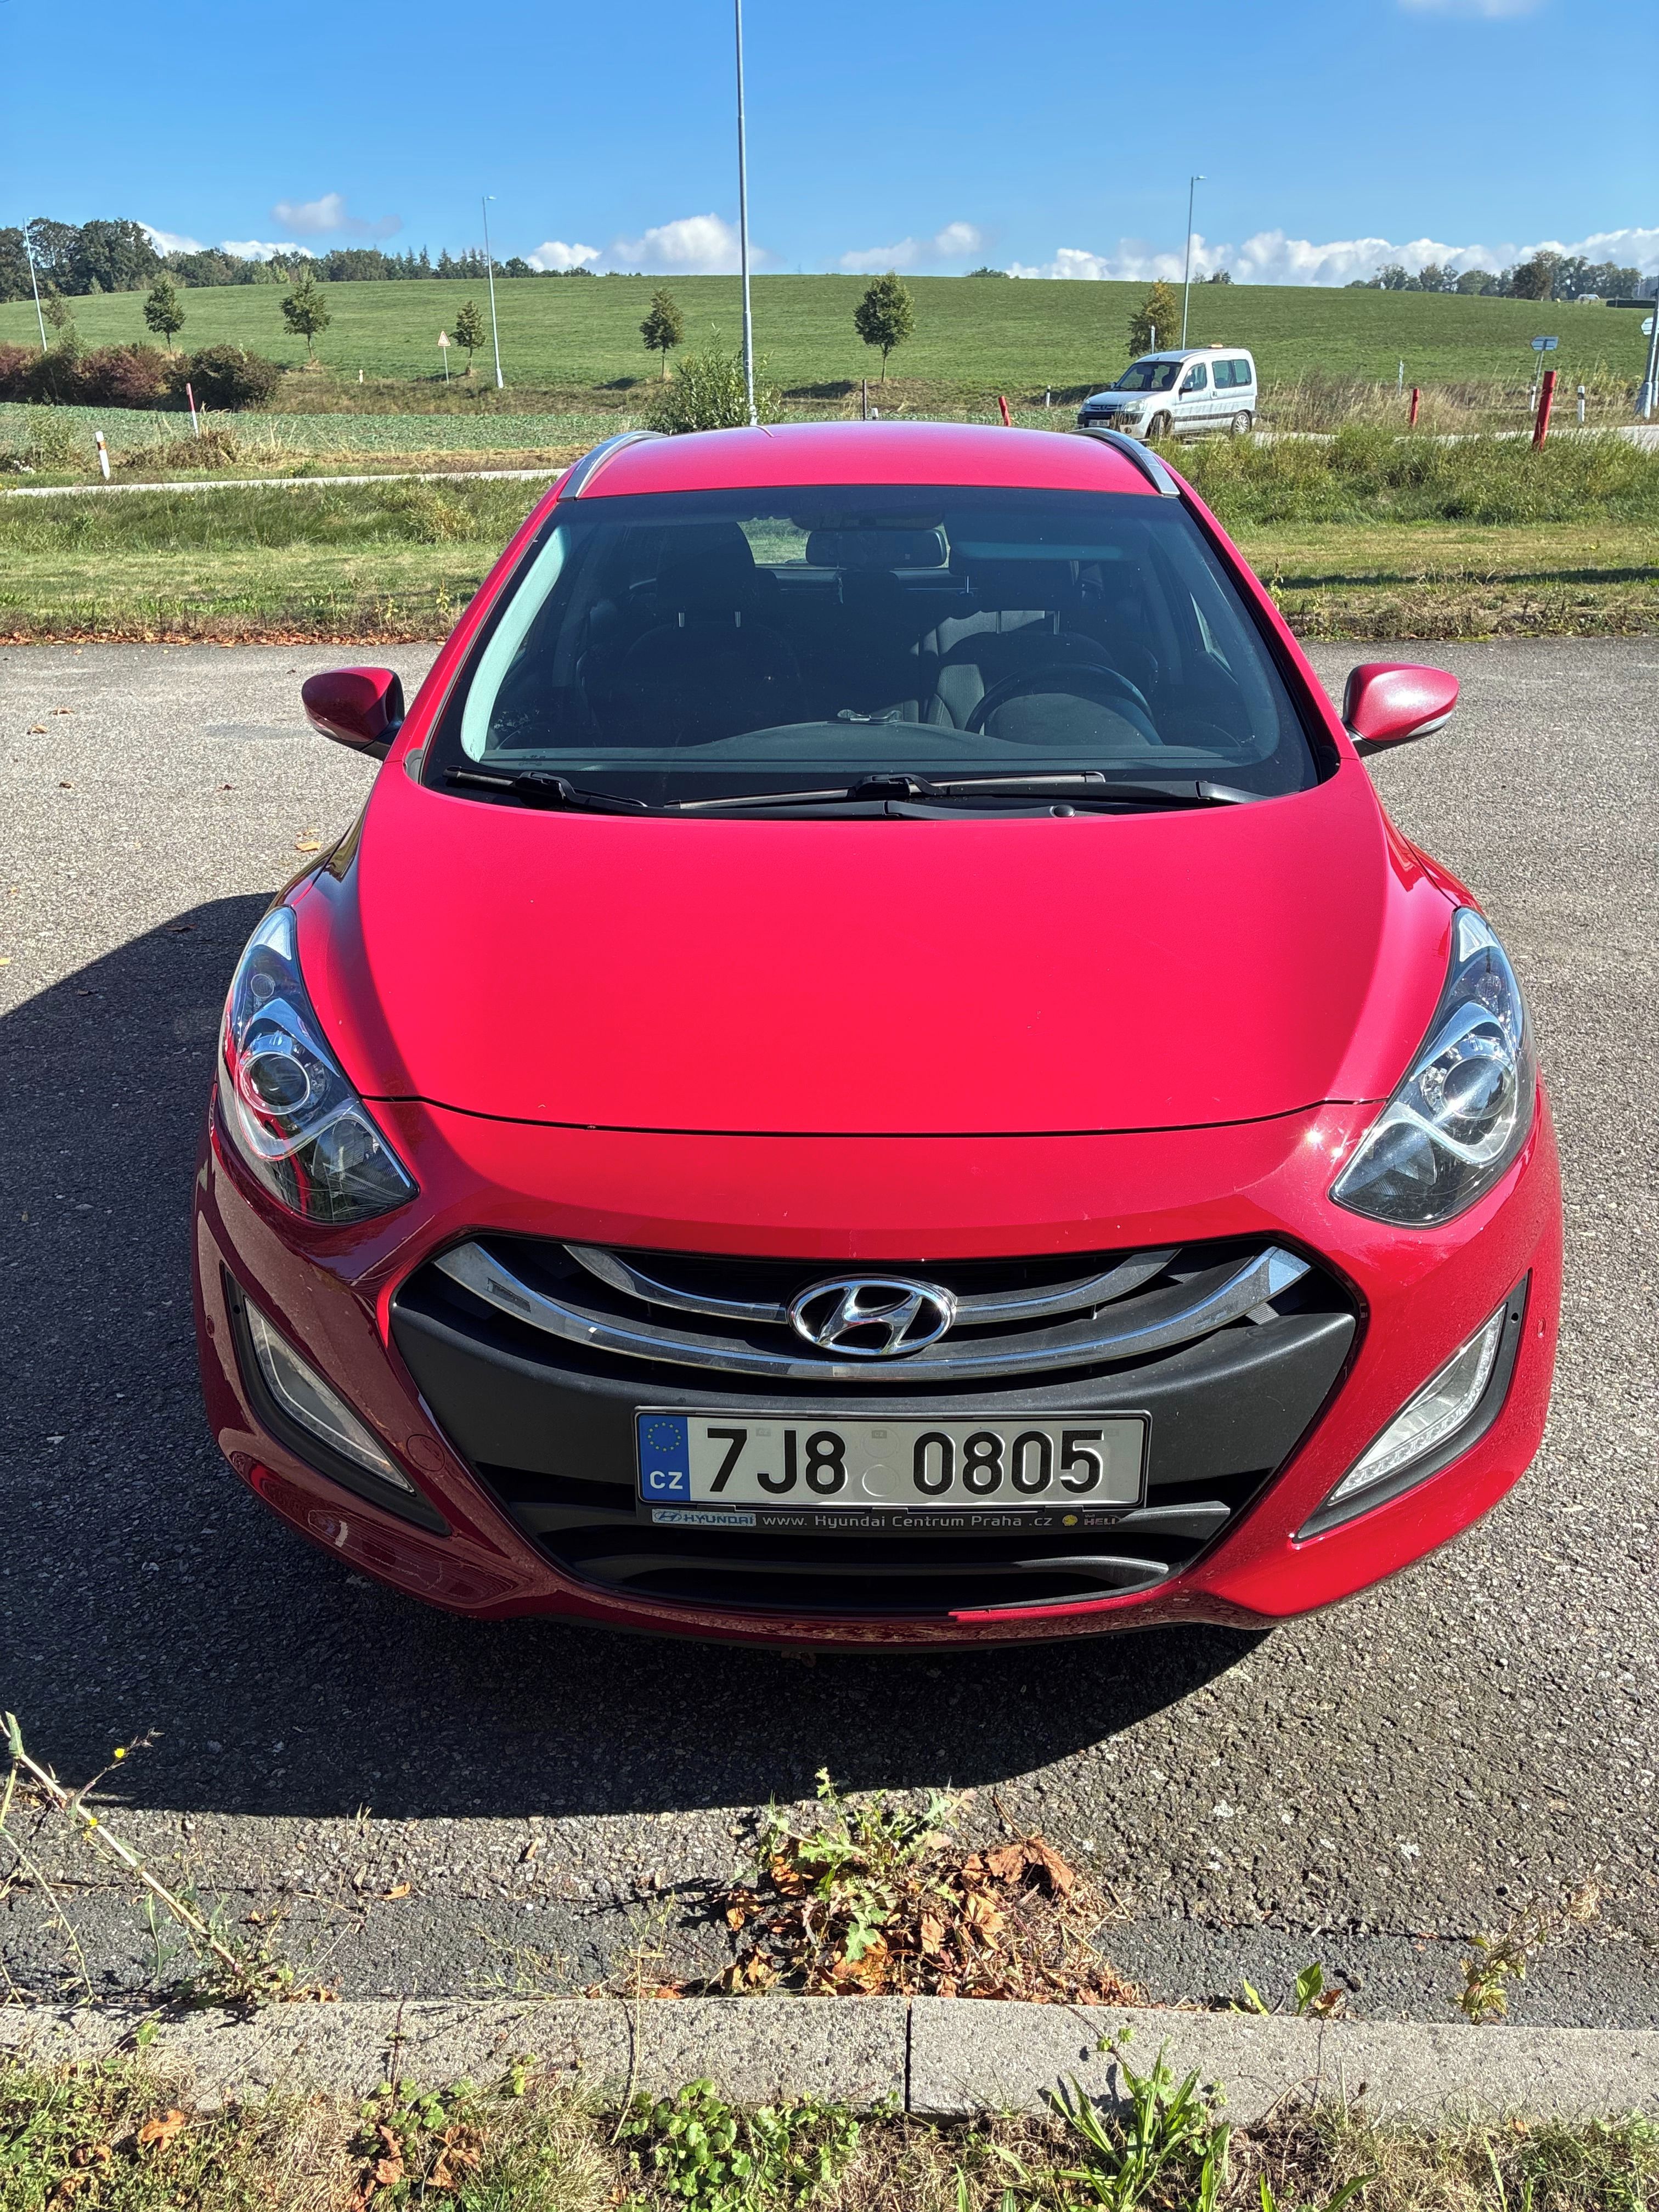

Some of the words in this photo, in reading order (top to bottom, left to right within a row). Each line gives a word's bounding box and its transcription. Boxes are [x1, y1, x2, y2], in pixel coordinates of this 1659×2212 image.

[707, 1429, 848, 1494] 7J8
[913, 1430, 1104, 1495] 0805
[650, 1470, 683, 1490] CZ
[684, 1514, 754, 1525] HYUNDAI
[763, 1517, 807, 1526] www.
[815, 1515, 885, 1528] Hyundai
[892, 1515, 964, 1527] Centrum
[971, 1515, 1022, 1526] Praha
[1029, 1516, 1053, 1526] .cz
